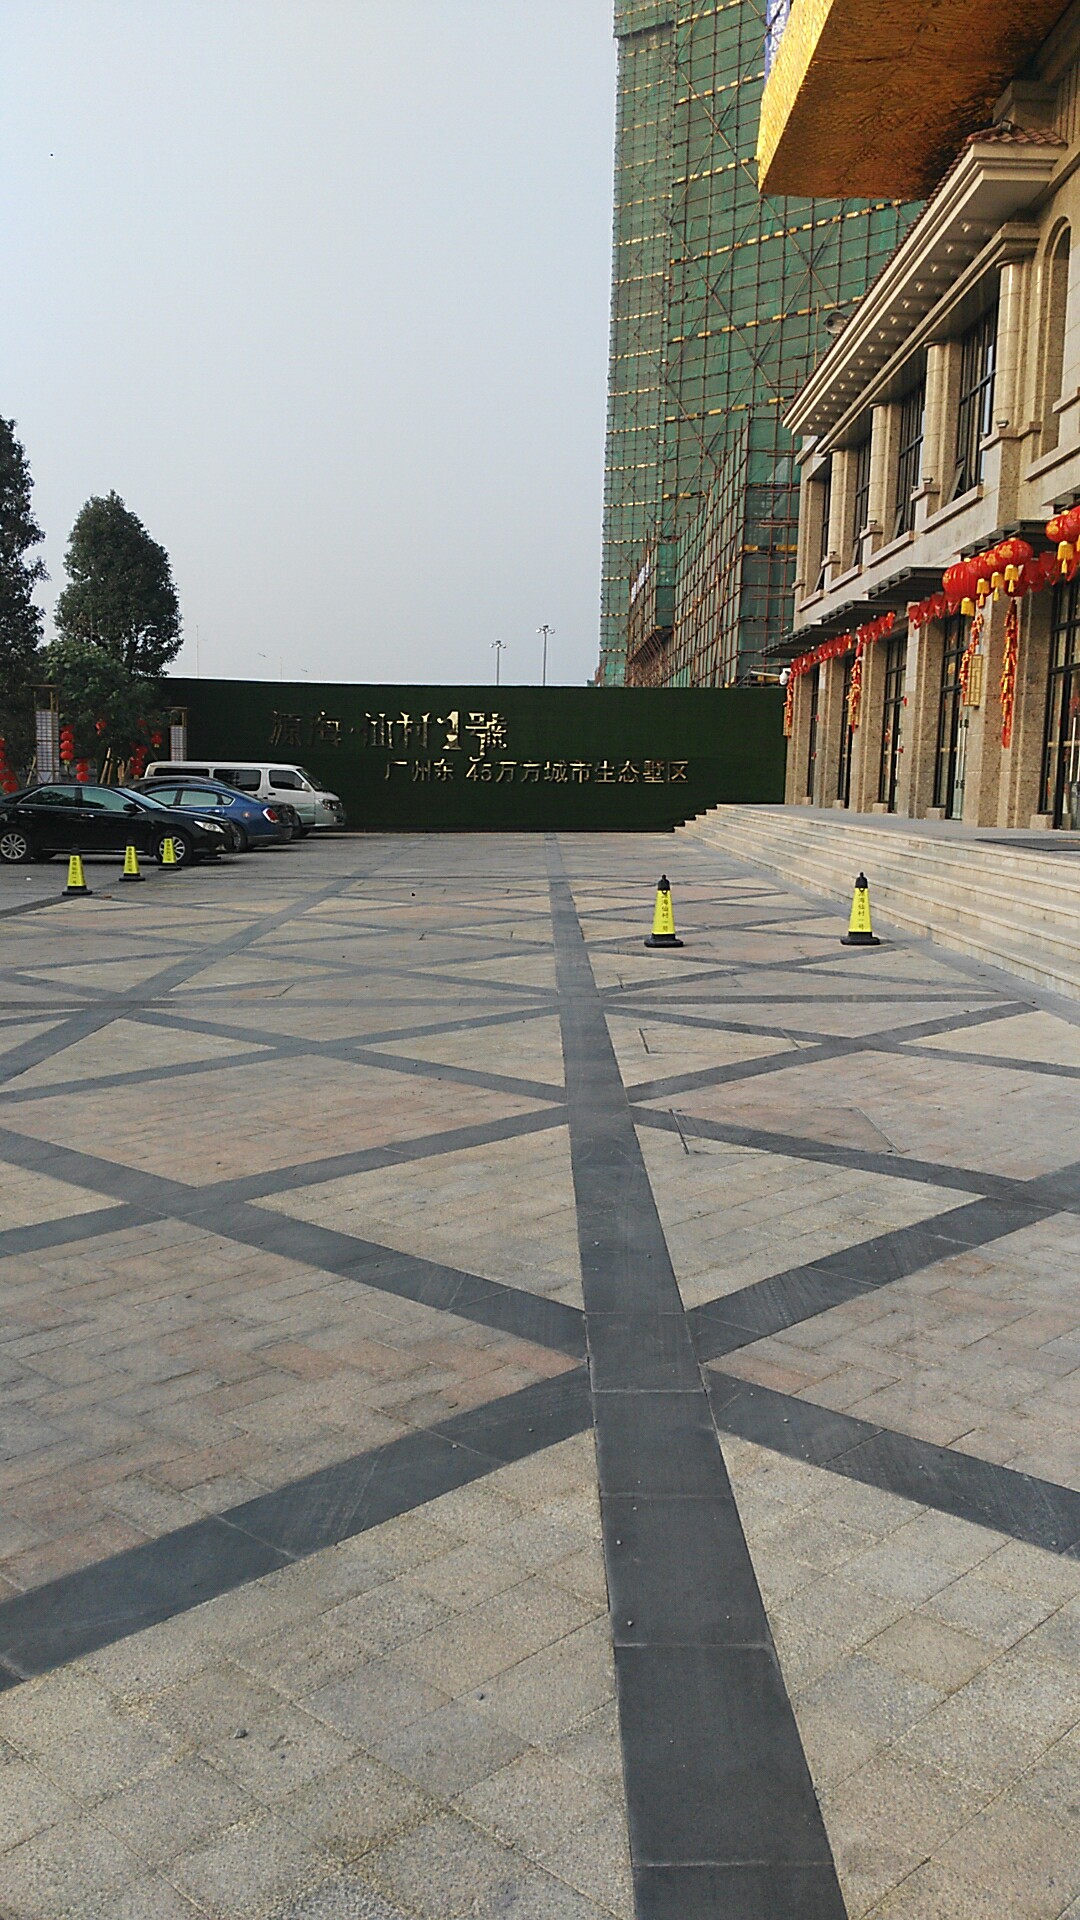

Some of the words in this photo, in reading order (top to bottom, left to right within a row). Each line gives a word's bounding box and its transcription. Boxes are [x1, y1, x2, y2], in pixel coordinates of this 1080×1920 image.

[384, 758, 455, 783] 广州东
[465, 759, 689, 784] 45万方城市生态墅区
